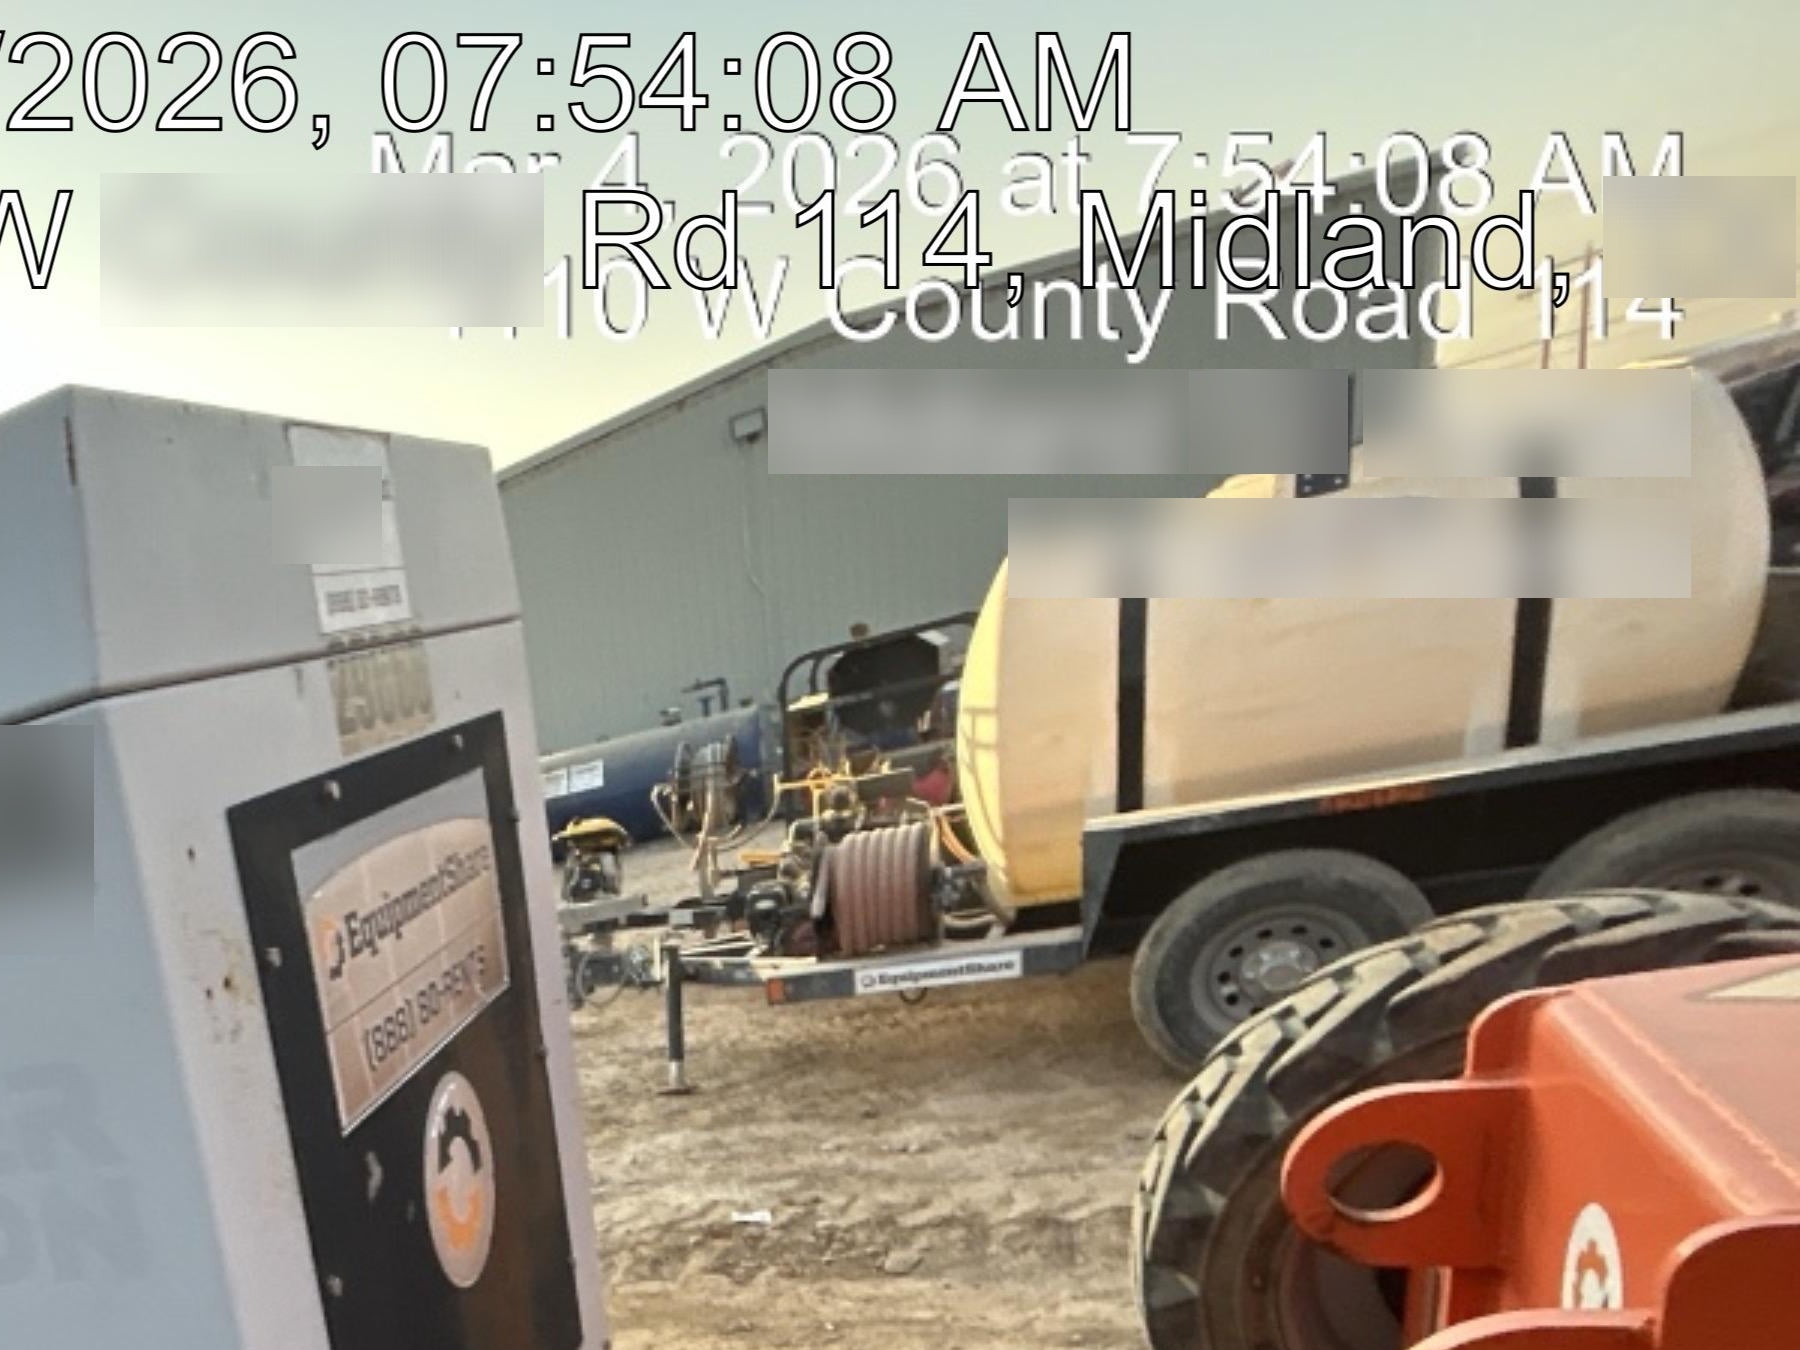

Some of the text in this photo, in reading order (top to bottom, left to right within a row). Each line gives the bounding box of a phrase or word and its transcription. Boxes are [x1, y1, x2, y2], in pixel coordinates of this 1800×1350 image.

[343, 845, 491, 959] EquipmentShare
[878, 960, 1015, 986] EquipmentShare
[362, 998, 418, 1071] (888)
